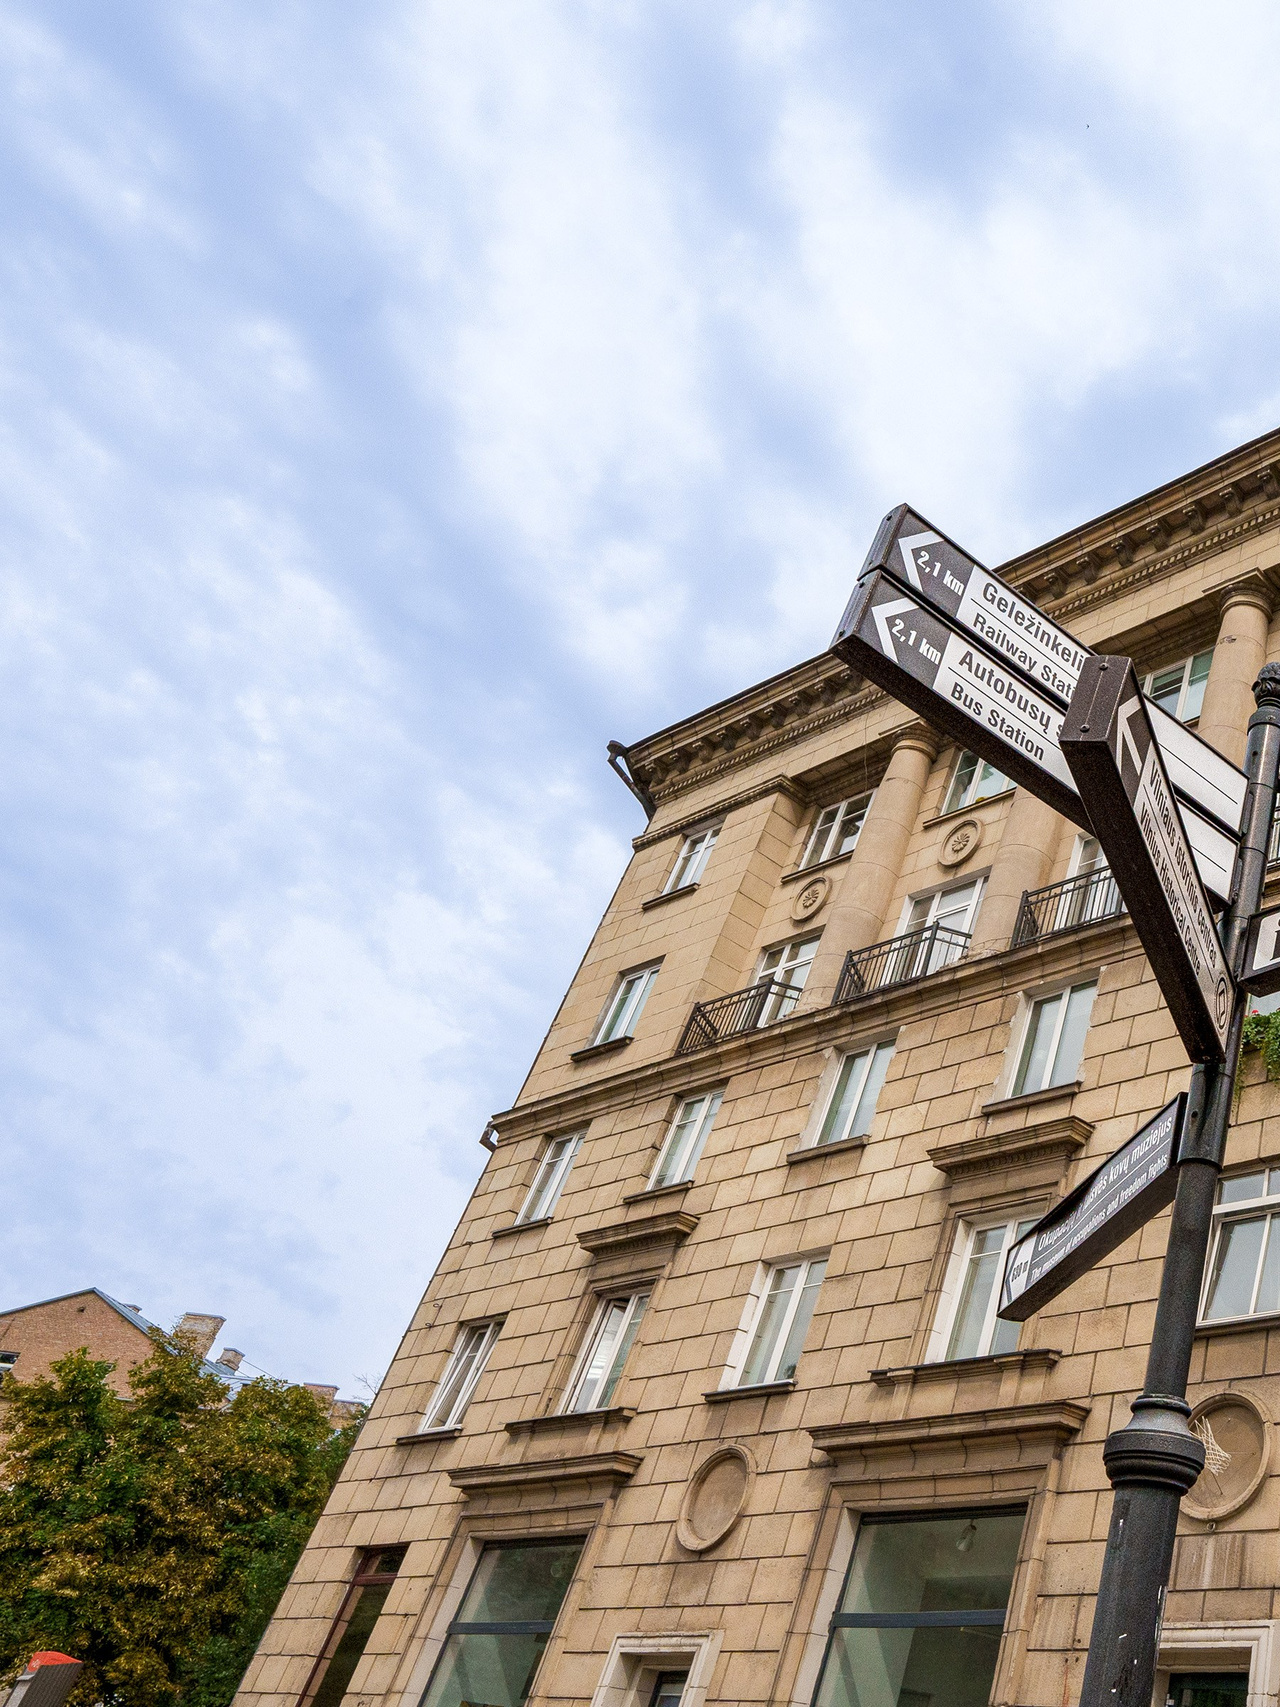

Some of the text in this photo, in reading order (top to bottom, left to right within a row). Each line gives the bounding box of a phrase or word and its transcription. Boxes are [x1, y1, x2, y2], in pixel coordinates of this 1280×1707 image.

[917, 550, 965, 597] 2,1 km
[891, 618, 942, 665] 2,1 km
[973, 612, 1076, 700] Railway Stati
[982, 582, 1085, 672] Geležinkeli
[950, 681, 1045, 762] Bus Station
[958, 650, 1052, 735] Autobusų
[1140, 801, 1201, 977] Vilnius Historical Centre
[1150, 759, 1217, 968] Vilniaus istorinis centras
[1120, 1172, 1147, 1204] freedom
[1148, 1153, 1168, 1181] fights
[1131, 1116, 1172, 1165] muziejus
